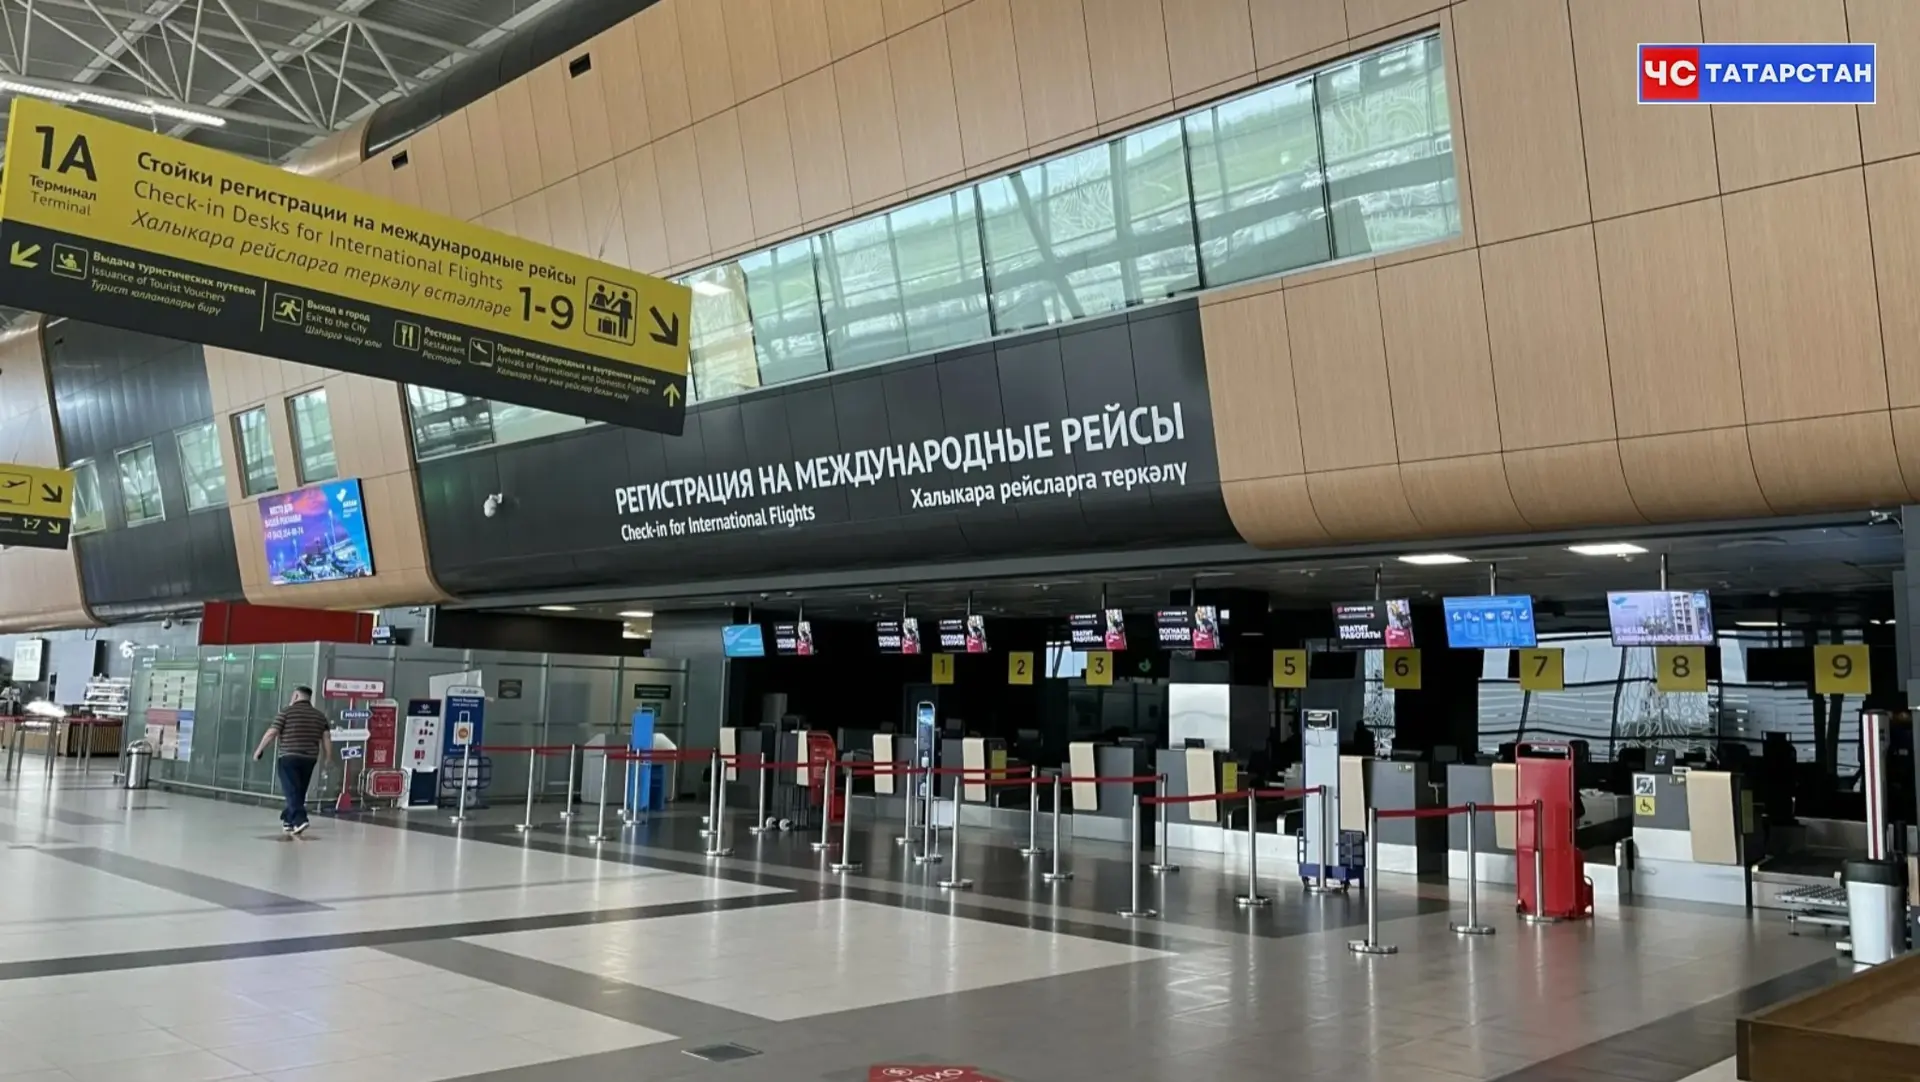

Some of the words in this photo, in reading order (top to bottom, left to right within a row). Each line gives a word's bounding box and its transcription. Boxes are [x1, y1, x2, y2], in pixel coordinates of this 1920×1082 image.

[35, 125, 98, 182] 1A
[29, 174, 97, 201] Терминал
[31, 190, 91, 216] Terminal
[137, 152, 213, 187] Стойки
[220, 176, 347, 224] регистрации
[353, 214, 375, 231] на
[381, 224, 524, 272] международные
[529, 257, 576, 286] рейсы
[133, 180, 225, 219] Check-in
[233, 204, 290, 236] Desks
[297, 221, 323, 243] for
[329, 229, 443, 276] International
[448, 262, 504, 293] Flights
[93, 251, 135, 270] Выдача
[138, 263, 214, 287] туристических
[216, 281, 257, 297] путевок
[132, 209, 235, 250] Халыкара
[240, 238, 338, 276] рейсларга
[345, 265, 422, 298] теркәлү
[423, 284, 512, 319] өстәлләре
[91, 266, 134, 282] Issuance
[136, 276, 147, 286] of
[149, 278, 181, 294] Tourist
[183, 286, 226, 303] Vouchers
[91, 279, 129, 296] Турист
[307, 300, 336, 315] Выход
[338, 308, 344, 316] в
[345, 309, 371, 323] город
[518, 287, 575, 330] 1-9
[306, 313, 323, 324] Exit
[324, 316, 334, 326] to
[335, 318, 350, 329] the
[351, 322, 368, 335] City
[424, 326, 462, 343] Ресторан
[423, 338, 466, 356] Restaurant
[526, 350, 586, 370] международных
[496, 355, 525, 369] Arrivals
[526, 361, 535, 370] of
[535, 363, 580, 380] International
[581, 372, 595, 383] and
[595, 375, 626, 391] Domestic
[627, 382, 650, 396] Flights
[614, 468, 755, 515] РЕГИСТРАЦИЯ
[758, 462, 793, 496] НА
[794, 421, 1054, 490] МЕЖДУНАРОДНЫЕ
[1061, 402, 1186, 455] РЕЙСЫ
[910, 481, 996, 509] Халыкара
[1000, 471, 1098, 504] рейсларга
[1101, 461, 1189, 491] теркәлү
[23, 517, 41, 529] 1-7
[620, 521, 668, 542] Check-in
[669, 519, 687, 537] for
[688, 507, 767, 533] International
[769, 503, 816, 529] Flights
[940, 659, 946, 675] 1
[1017, 659, 1025, 675] 2
[1095, 658, 1104, 675] 3
[1284, 657, 1296, 676] 5
[1394, 656, 1409, 676] 6
[1532, 656, 1548, 676] 7
[1672, 655, 1690, 677] 8
[1831, 654, 1852, 678] 9
